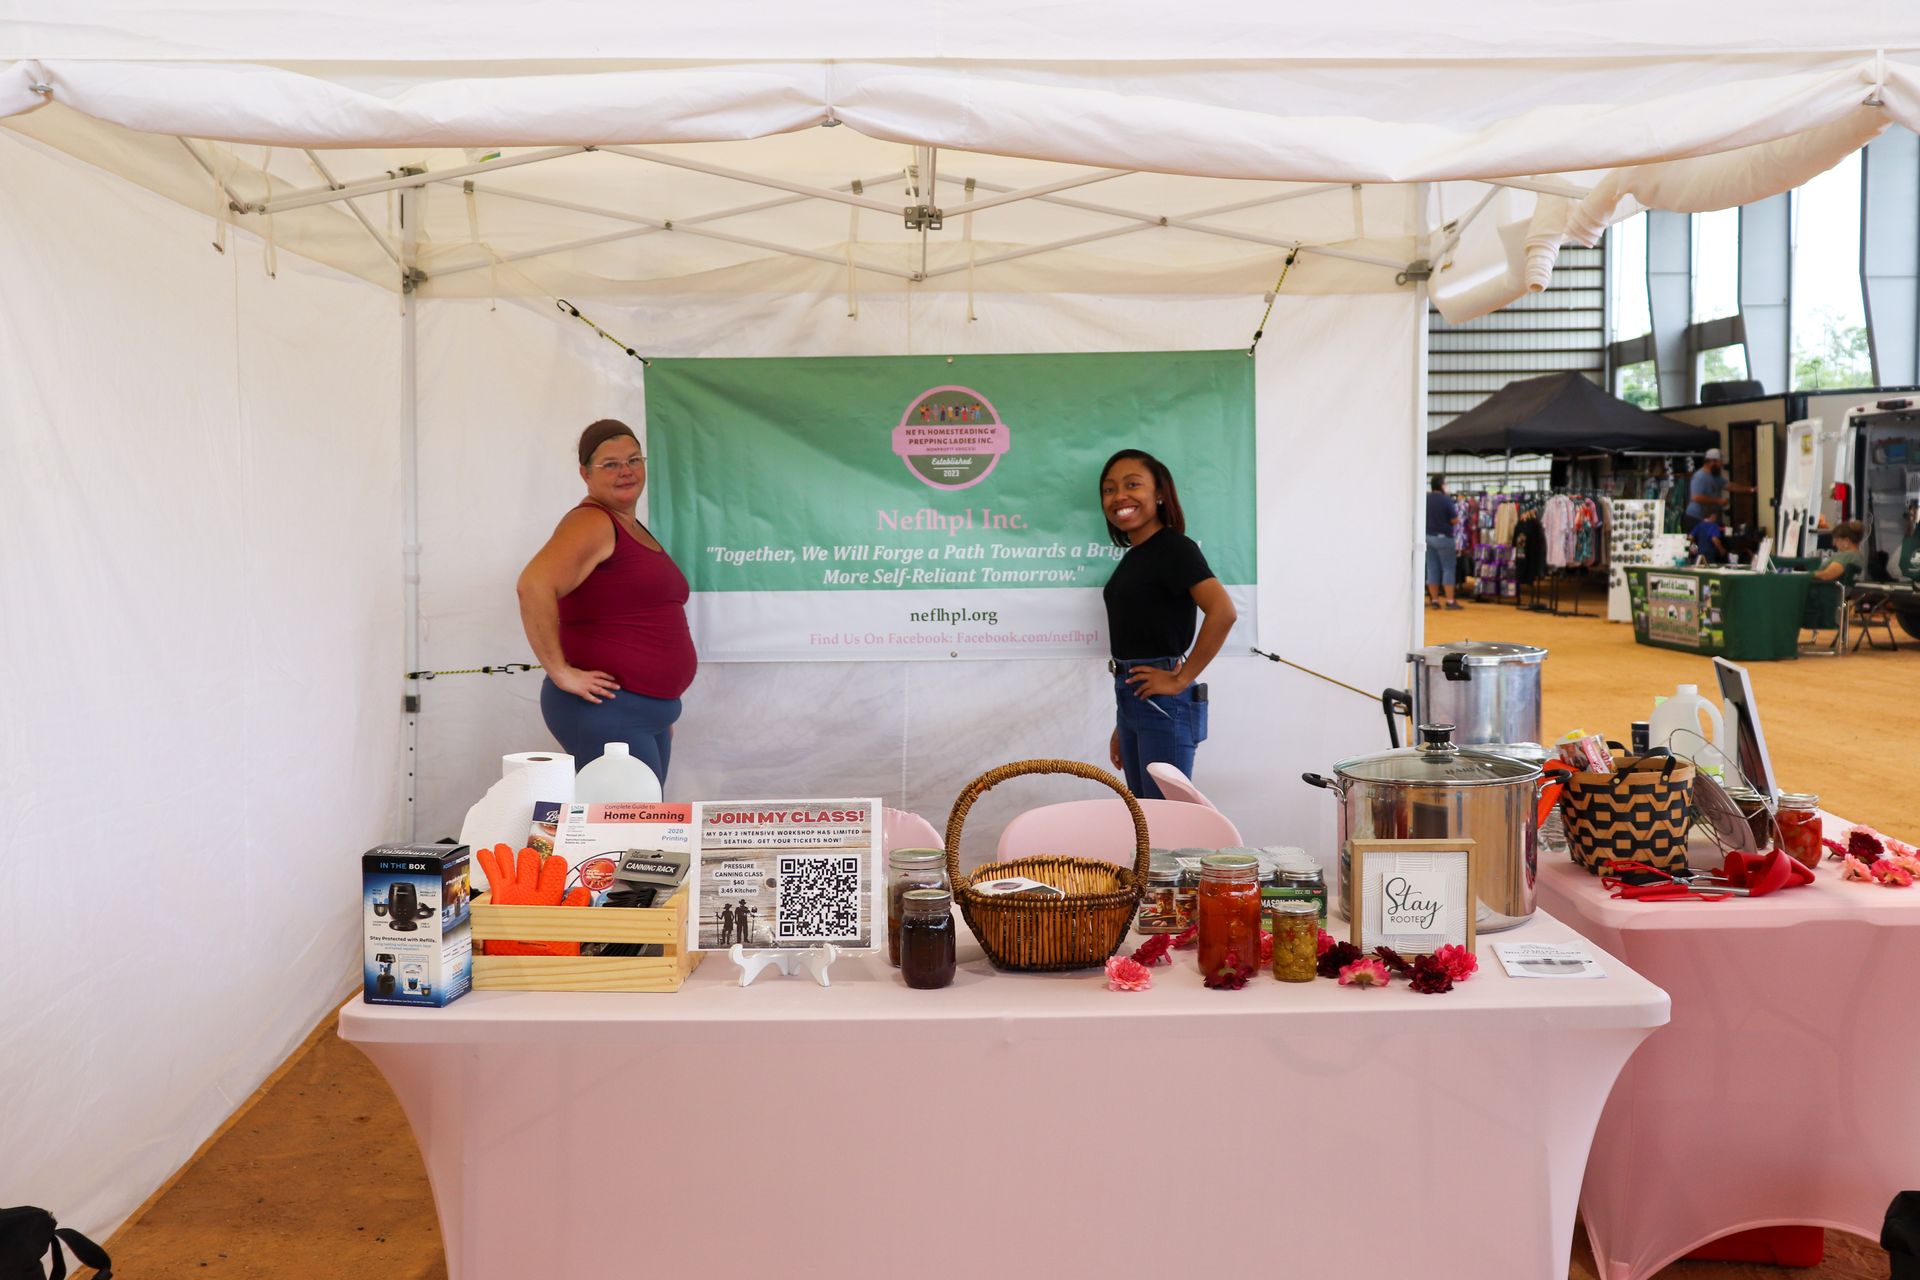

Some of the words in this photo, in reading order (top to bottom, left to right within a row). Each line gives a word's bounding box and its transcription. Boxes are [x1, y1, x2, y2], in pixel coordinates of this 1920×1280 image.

[949, 437, 977, 445] LADIES
[931, 457, 973, 465] Established
[943, 469, 960, 477] 2023
[981, 508, 1029, 529] Inc.
[706, 546, 797, 566] "Together,
[802, 545, 829, 561] We
[833, 544, 869, 561] Will
[873, 545, 924, 564] Forge
[928, 548, 939, 560] a
[944, 543, 985, 559] Path
[990, 543, 1066, 559] Towards
[1071, 546, 1081, 558] a
[823, 568, 869, 584] More
[873, 567, 979, 587] Self-Reliant
[981, 565, 1085, 582] Tomorrow."
[910, 608, 998, 625] neflhpl.org
[810, 633, 839, 645] Find
[843, 633, 860, 645] Us
[864, 632, 884, 644] On
[888, 632, 952, 644] Facebook:
[957, 630, 1099, 646] Facebook.com/neflhpl
[604, 811, 636, 820] Home
[639, 811, 685, 822] Canning
[709, 811, 755, 825] JOIN
[757, 810, 789, 824] MY
[790, 809, 865, 824] CLASS!
[391, 862, 407, 870] THE
[408, 863, 426, 871] BOX
[625, 862, 656, 872] CANNING
[656, 865, 677, 873] RACK
[1385, 877, 1444, 930] Stay
[1390, 915, 1427, 923] ROOTED
